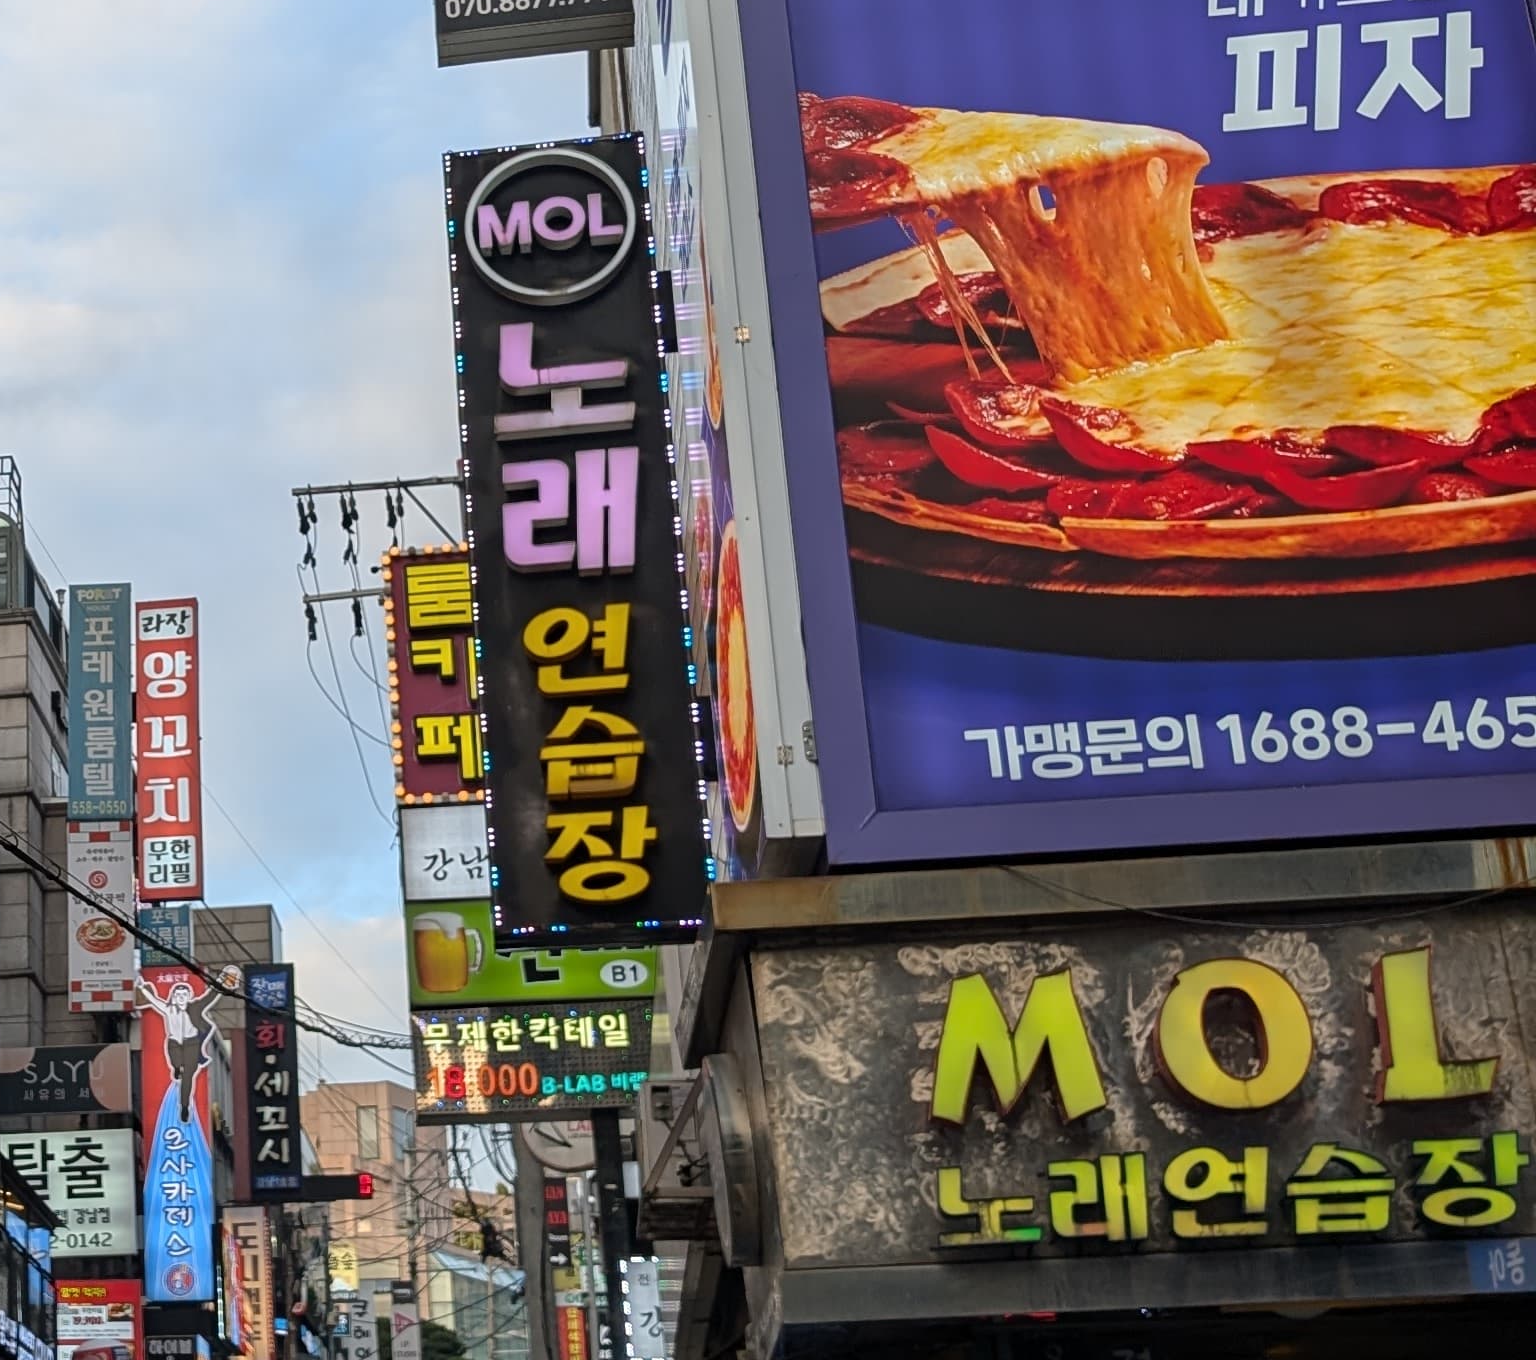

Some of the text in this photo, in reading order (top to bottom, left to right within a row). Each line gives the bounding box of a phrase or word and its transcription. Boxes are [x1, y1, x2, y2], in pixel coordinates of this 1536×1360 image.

[1222, 11, 1485, 133] 피자
[476, 191, 624, 255] MOL
[141, 609, 189, 635] 라장
[494, 321, 658, 906] 노래연습장
[142, 650, 193, 823] 양꼬치
[964, 712, 1204, 782] 가맹문의
[71, 800, 127, 816] 558-0550
[149, 840, 191, 860] 무한
[149, 864, 192, 884] 리필
[610, 962, 640, 983] B1
[929, 944, 1502, 1130] MOL
[541, 1074, 608, 1095] B-LAB
[73, 1207, 111, 1225] 강남점
[160, 1127, 196, 1256] 오사카데스
[938, 1131, 1531, 1248] 노래연습장
